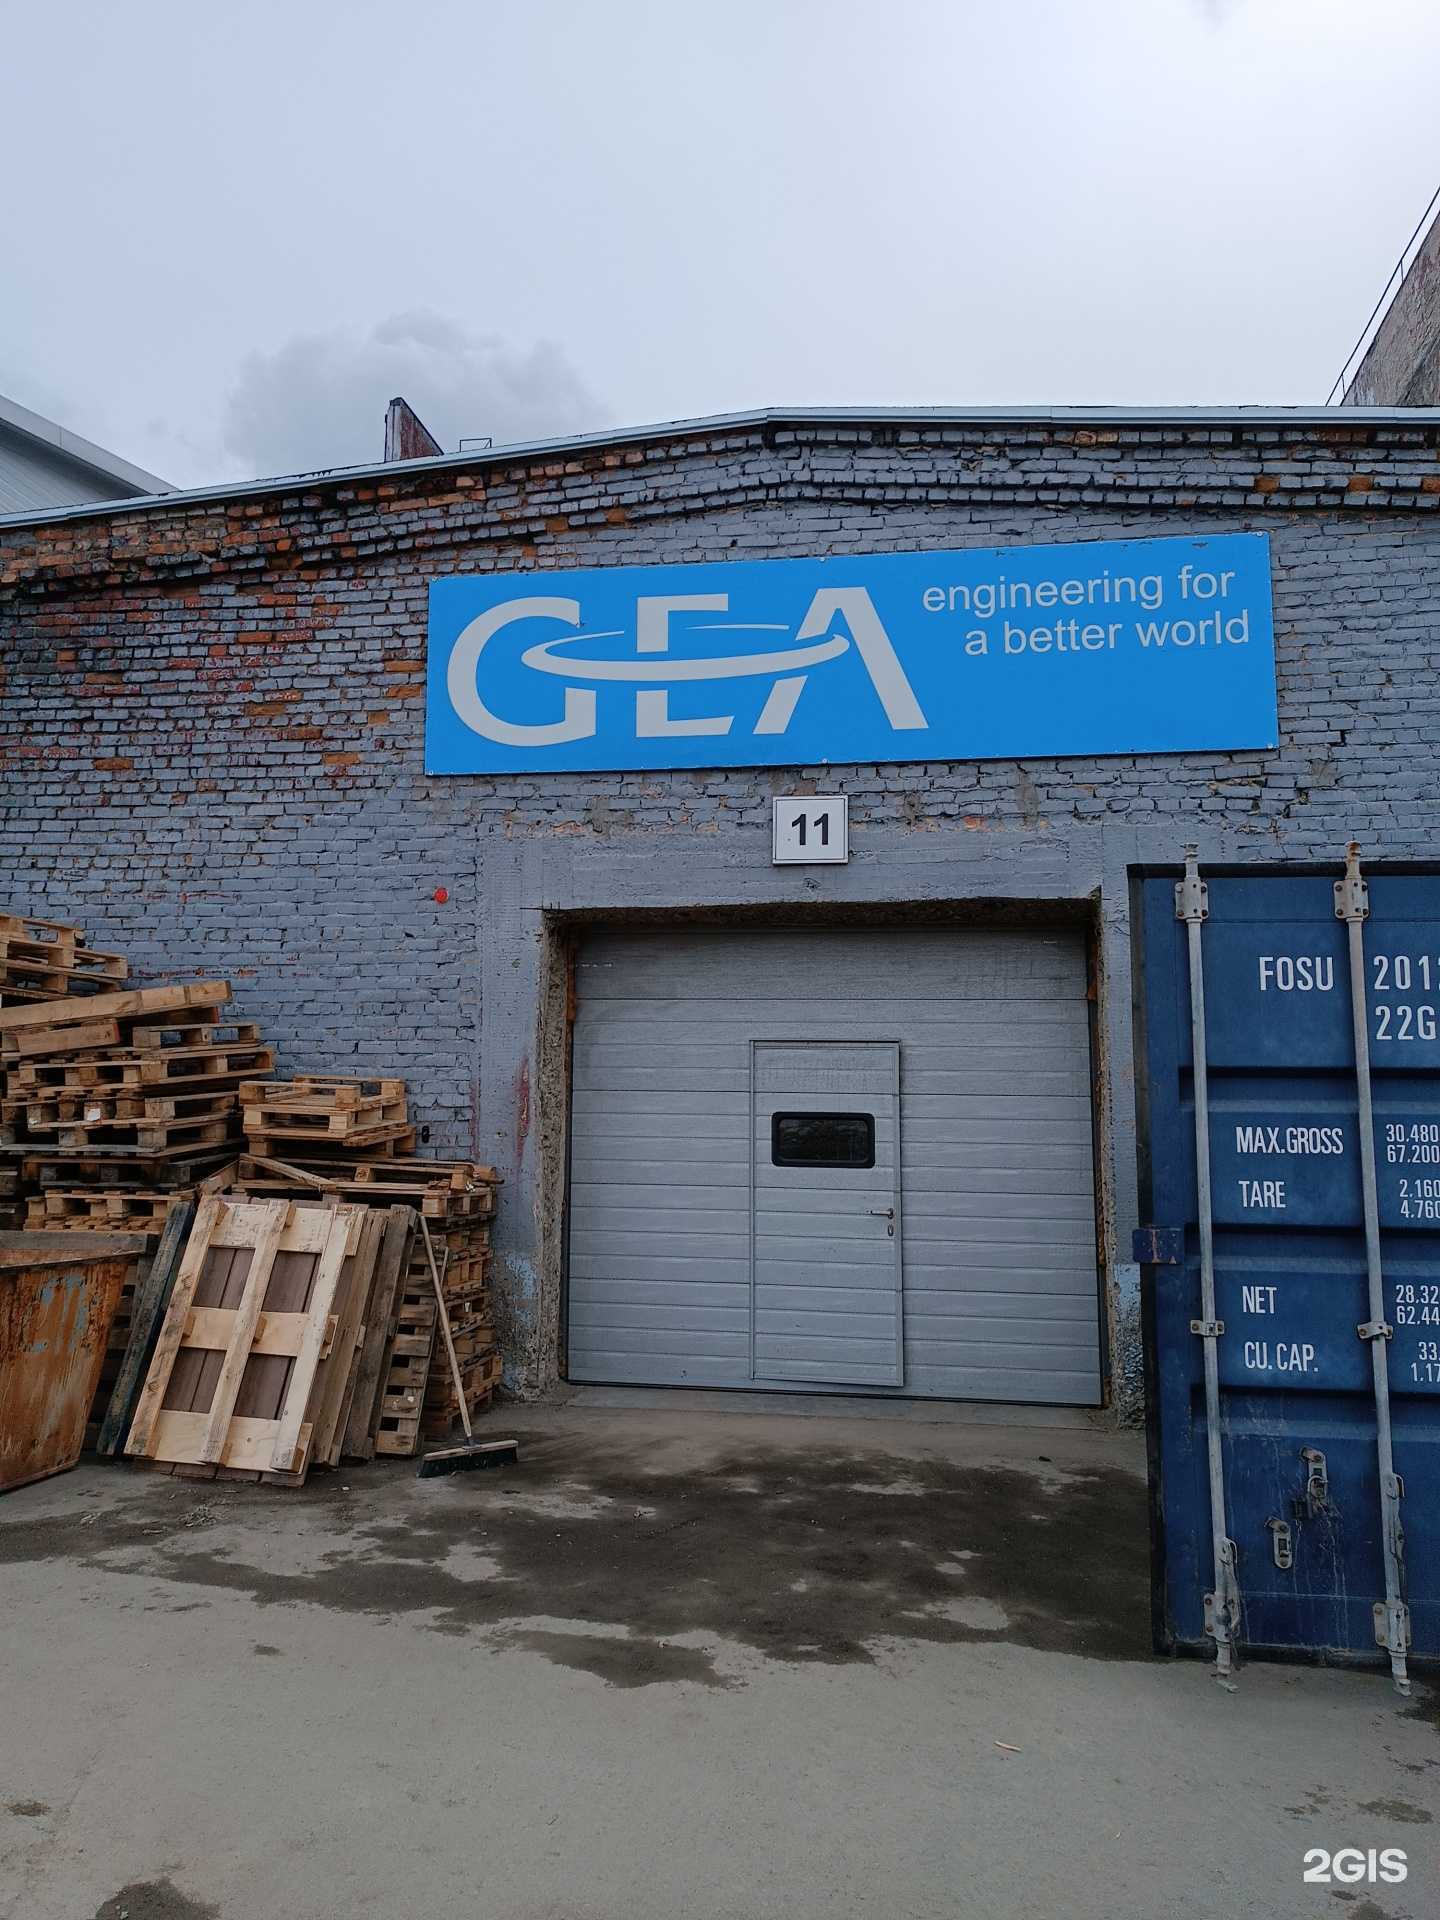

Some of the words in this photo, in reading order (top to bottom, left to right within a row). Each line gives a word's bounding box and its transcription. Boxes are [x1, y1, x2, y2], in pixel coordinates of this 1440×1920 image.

[922, 569, 1163, 619] engineering
[1177, 564, 1236, 600] for
[964, 628, 988, 656] a
[1003, 618, 1122, 654] better
[1136, 608, 1250, 647] world
[446, 586, 929, 747] GEA
[791, 812, 829, 846] 11
[1258, 956, 1334, 991] FOSU
[1373, 955, 1440, 990] 201
[1375, 1005, 1437, 1040] 22G
[1235, 1126, 1344, 1154] MAX.GROSS
[1385, 1123, 1439, 1142] 30.480
[1387, 1144, 1440, 1163] 67.200
[1238, 1179, 1286, 1208] TARE
[1242, 1286, 1277, 1314] NET
[1244, 1341, 1273, 1369] CU.
[1276, 1342, 1319, 1372] CAP.
